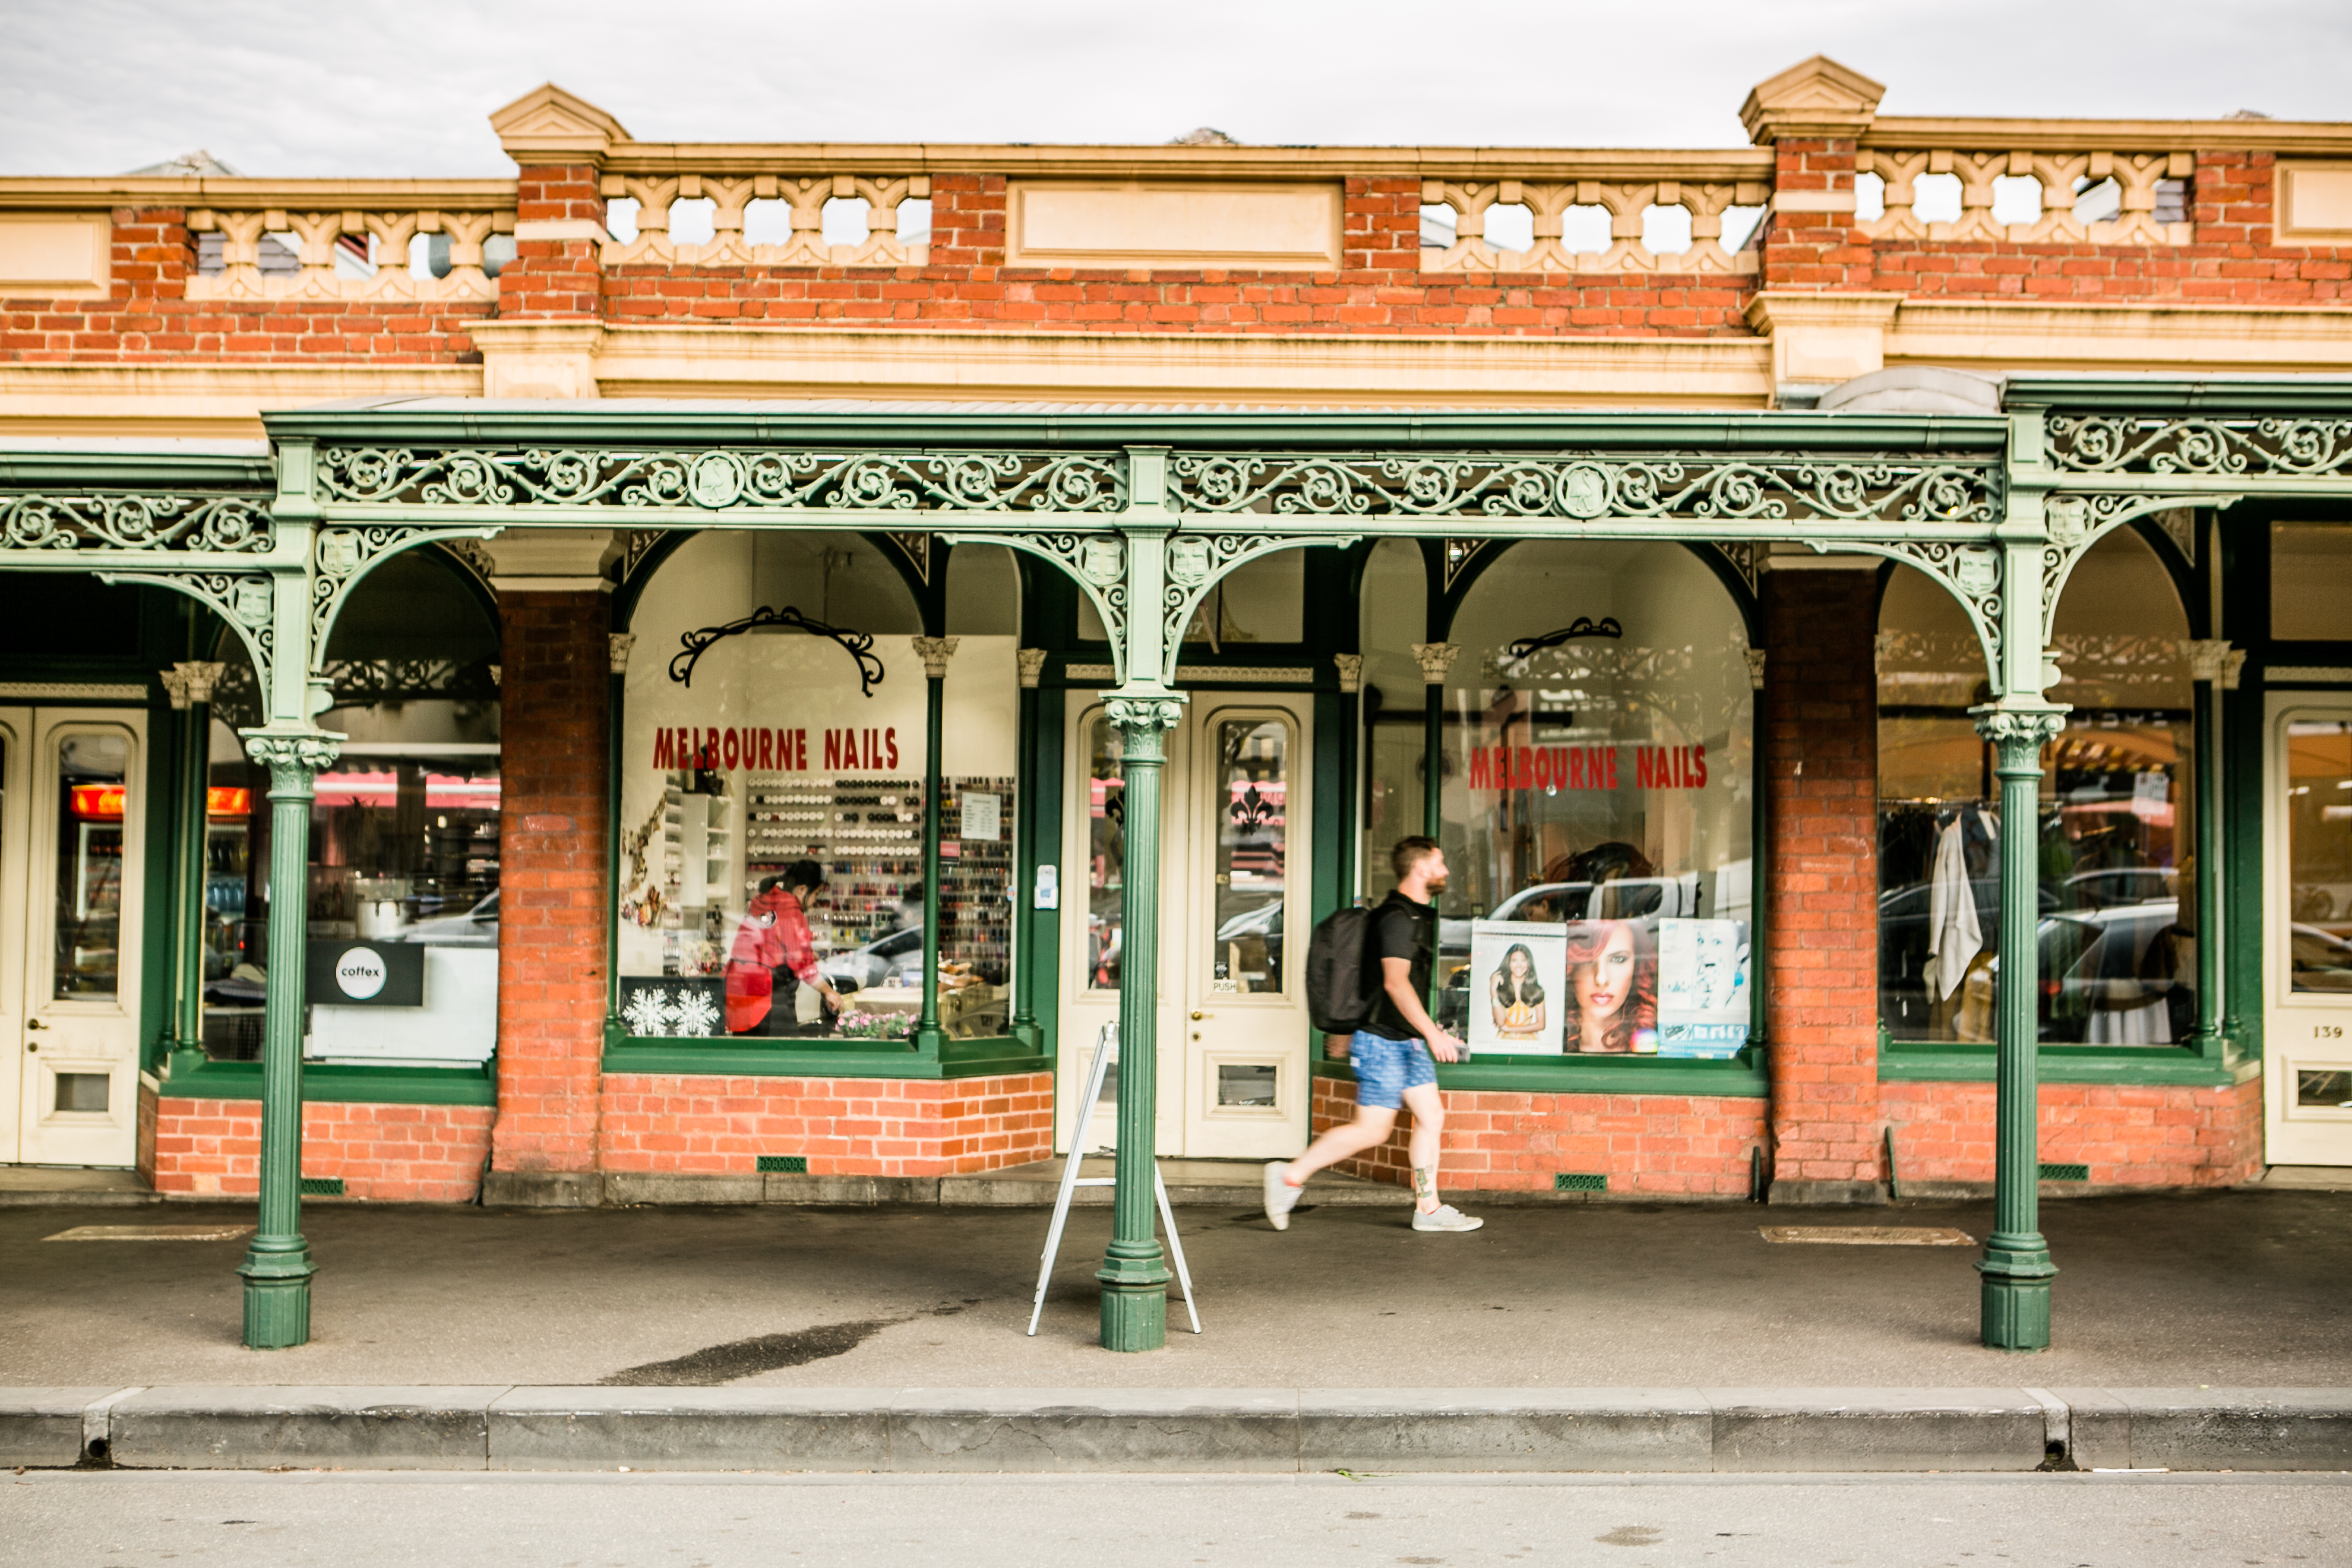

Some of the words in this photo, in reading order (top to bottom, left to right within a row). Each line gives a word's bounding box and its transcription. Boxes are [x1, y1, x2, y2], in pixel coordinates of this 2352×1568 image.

[653, 727, 808, 771] MELBOURNE
[824, 726, 899, 770] NAILS
[1469, 746, 1618, 791] MELBOURNE
[1636, 745, 1708, 790] NAILS
[341, 966, 380, 977] coffex
[1213, 982, 1236, 991] PUSH
[2314, 1026, 2342, 1038] 139
